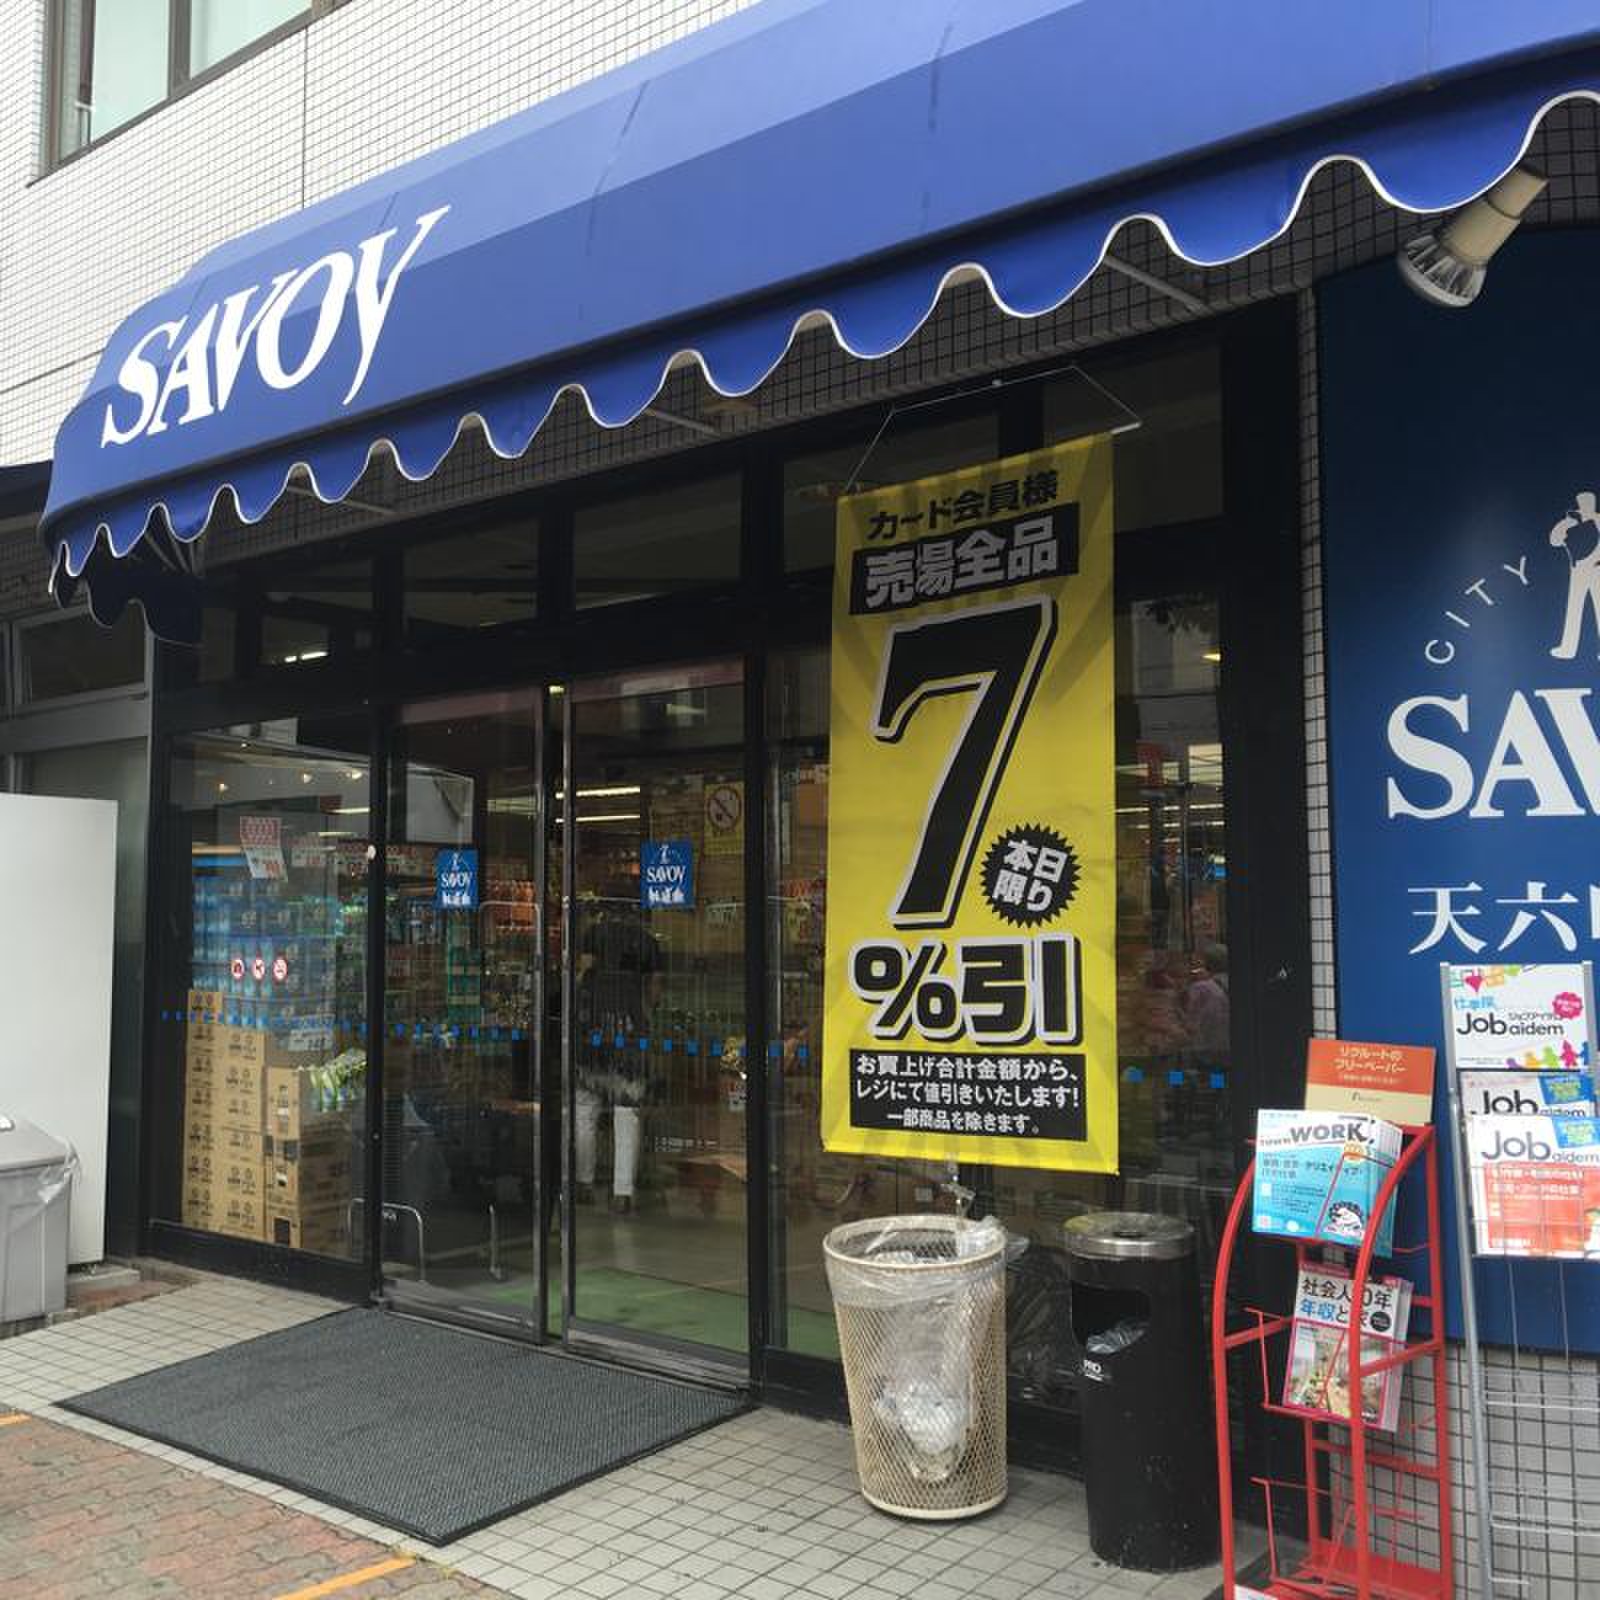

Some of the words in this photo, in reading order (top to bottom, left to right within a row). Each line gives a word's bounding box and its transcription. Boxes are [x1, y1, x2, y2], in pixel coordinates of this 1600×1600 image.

[101, 205, 451, 448] SAVOY
[866, 470, 1058, 540] カード会員様
[865, 515, 1058, 608] 売場全品
[1425, 556, 1530, 664] CITY
[872, 594, 1059, 931] 7
[992, 869, 1053, 912] 限り
[1003, 839, 1068, 883] 本日
[1408, 881, 1600, 955] 天六
[848, 934, 1083, 1047] %引
[1456, 1012, 1507, 1036] Job
[1508, 1022, 1564, 1036] aidem
[856, 1055, 1078, 1081] お買上げ合計金額から、
[887, 1108, 1040, 1134] 一部商品を除きます。
[1481, 1130, 1551, 1161] Job
